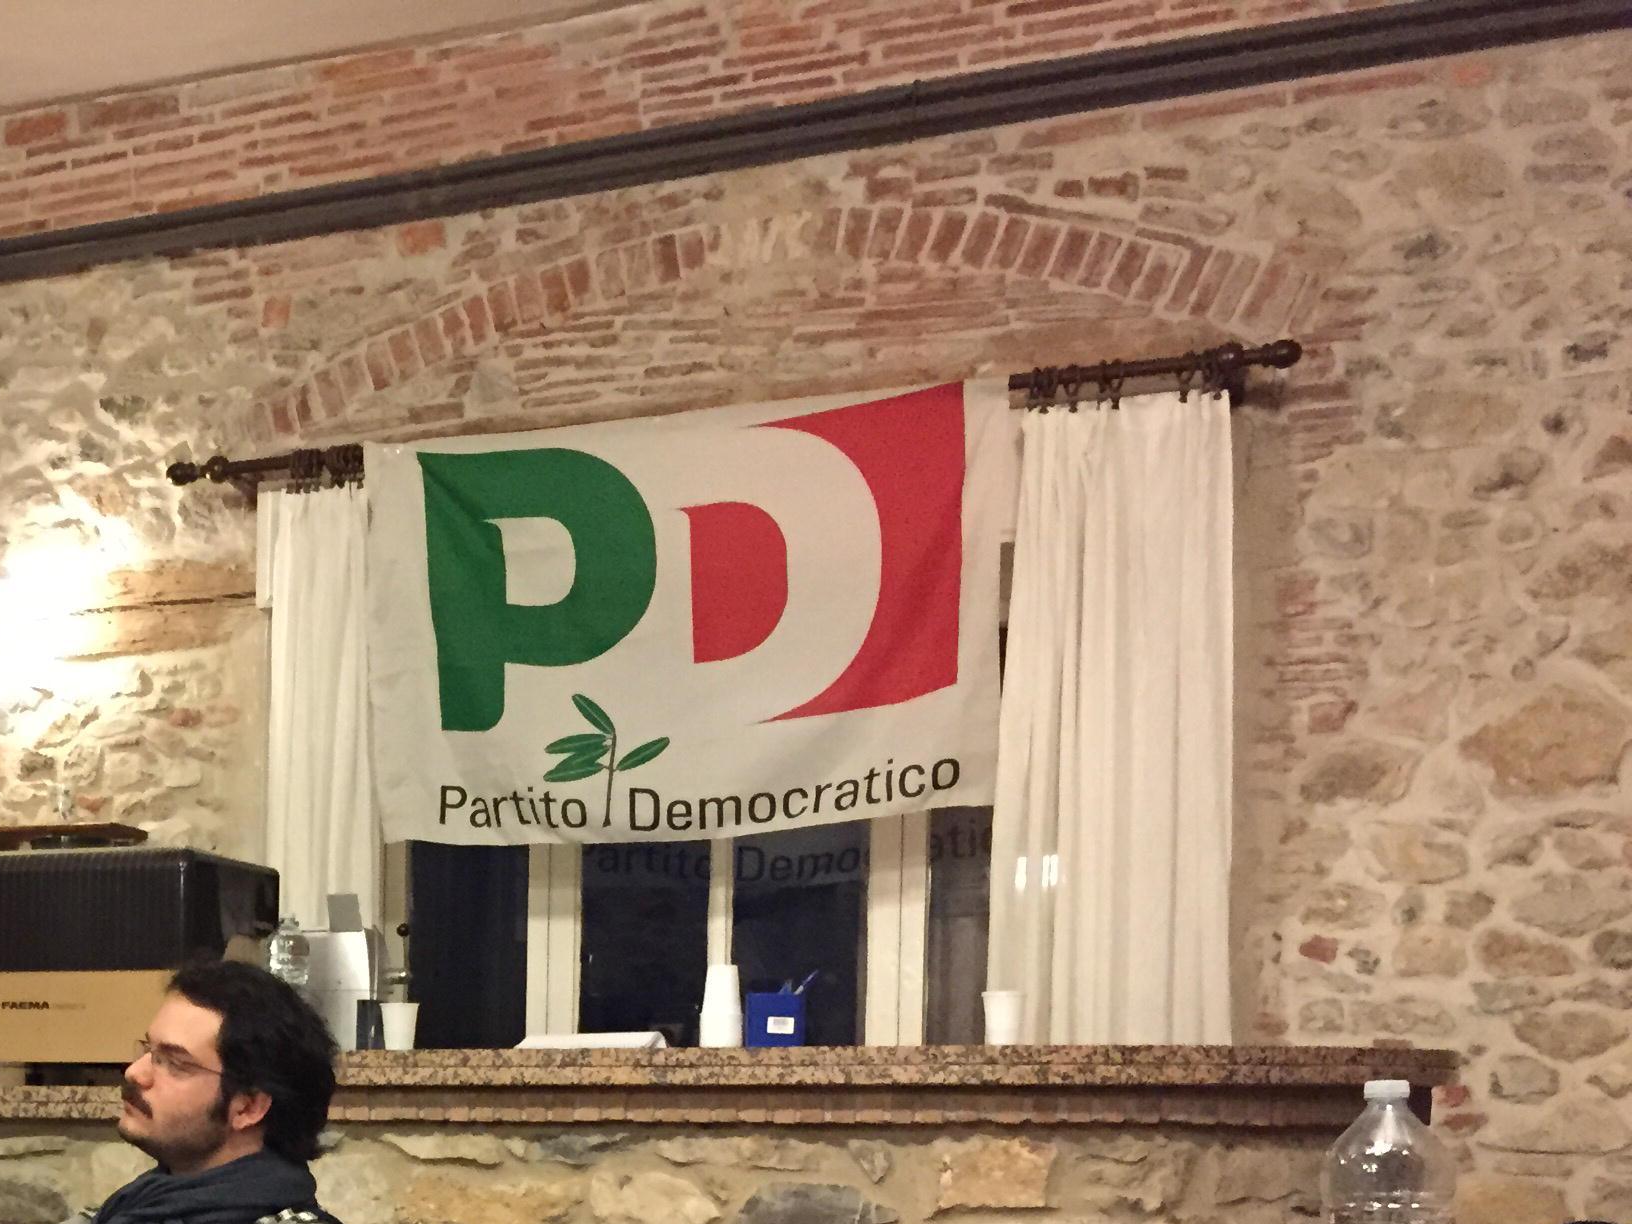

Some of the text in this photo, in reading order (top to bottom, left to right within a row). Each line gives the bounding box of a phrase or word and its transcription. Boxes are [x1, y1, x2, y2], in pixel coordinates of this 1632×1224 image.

[417, 426, 882, 733] PD
[438, 757, 962, 832] Partito Democratico
[582, 844, 709, 881] artito
[0, 1001, 50, 1010] FAEMA
